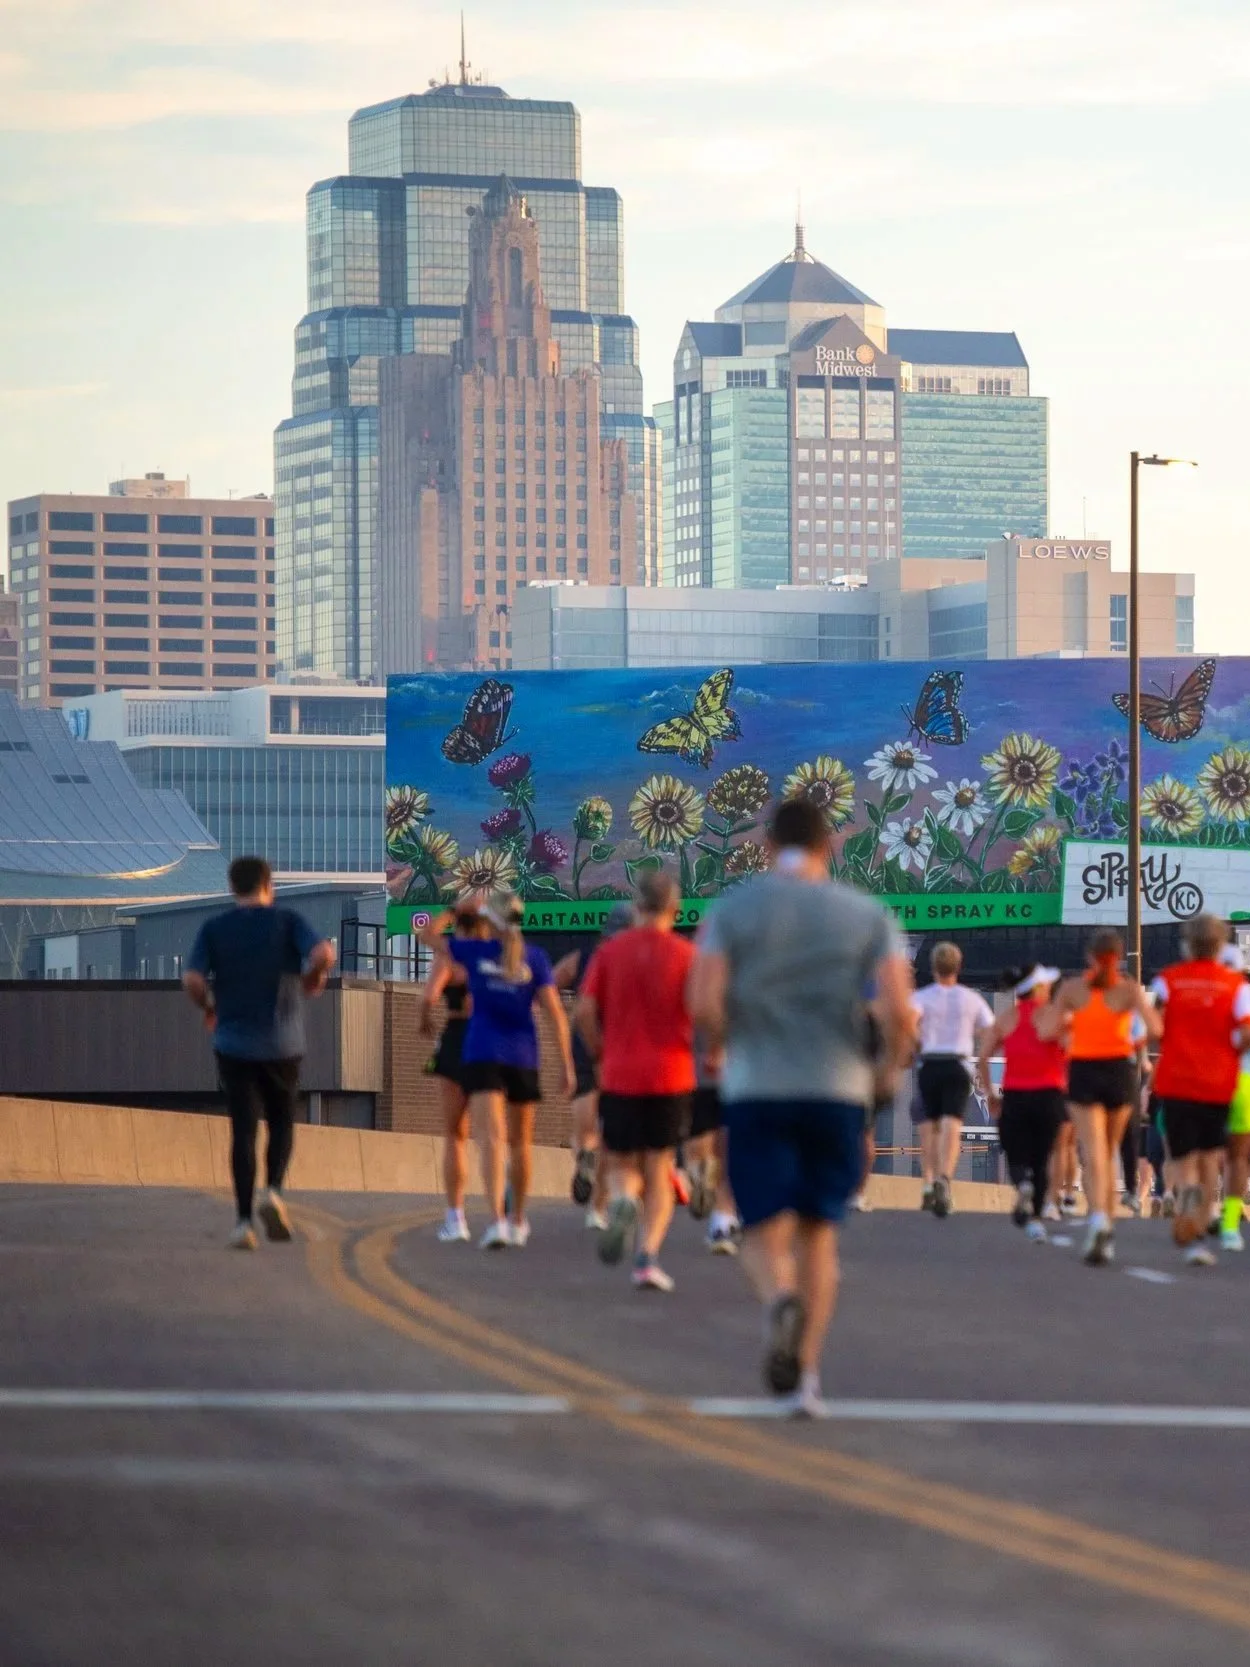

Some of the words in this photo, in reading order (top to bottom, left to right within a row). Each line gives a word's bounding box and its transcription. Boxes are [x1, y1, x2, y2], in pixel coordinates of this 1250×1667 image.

[815, 345, 857, 361] Bank
[815, 361, 878, 377] Midwest
[1019, 545, 1109, 560] LOEWS
[1174, 890, 1196, 911] KC
[928, 904, 995, 919] SPRAY
[1005, 904, 1033, 918] KC
